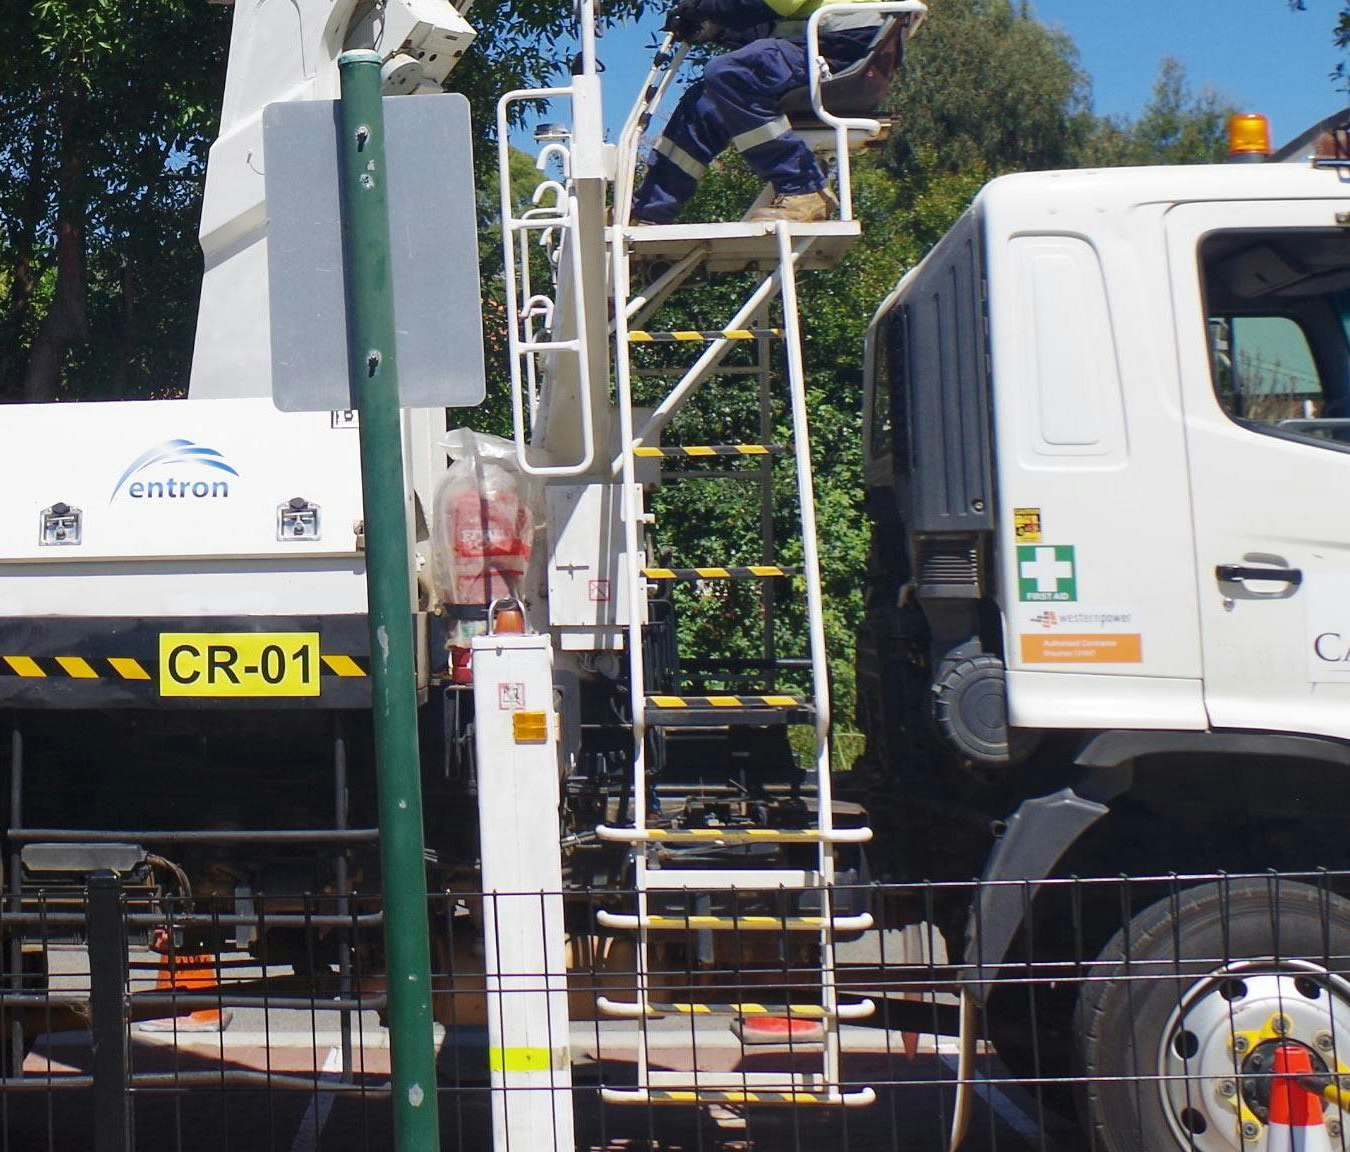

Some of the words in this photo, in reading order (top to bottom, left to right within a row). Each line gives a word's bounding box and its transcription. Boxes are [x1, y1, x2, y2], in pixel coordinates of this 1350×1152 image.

[129, 477, 229, 498] entron
[1026, 592, 1052, 601] FIRST
[1053, 592, 1070, 601] AID
[168, 644, 310, 685] CR-01
